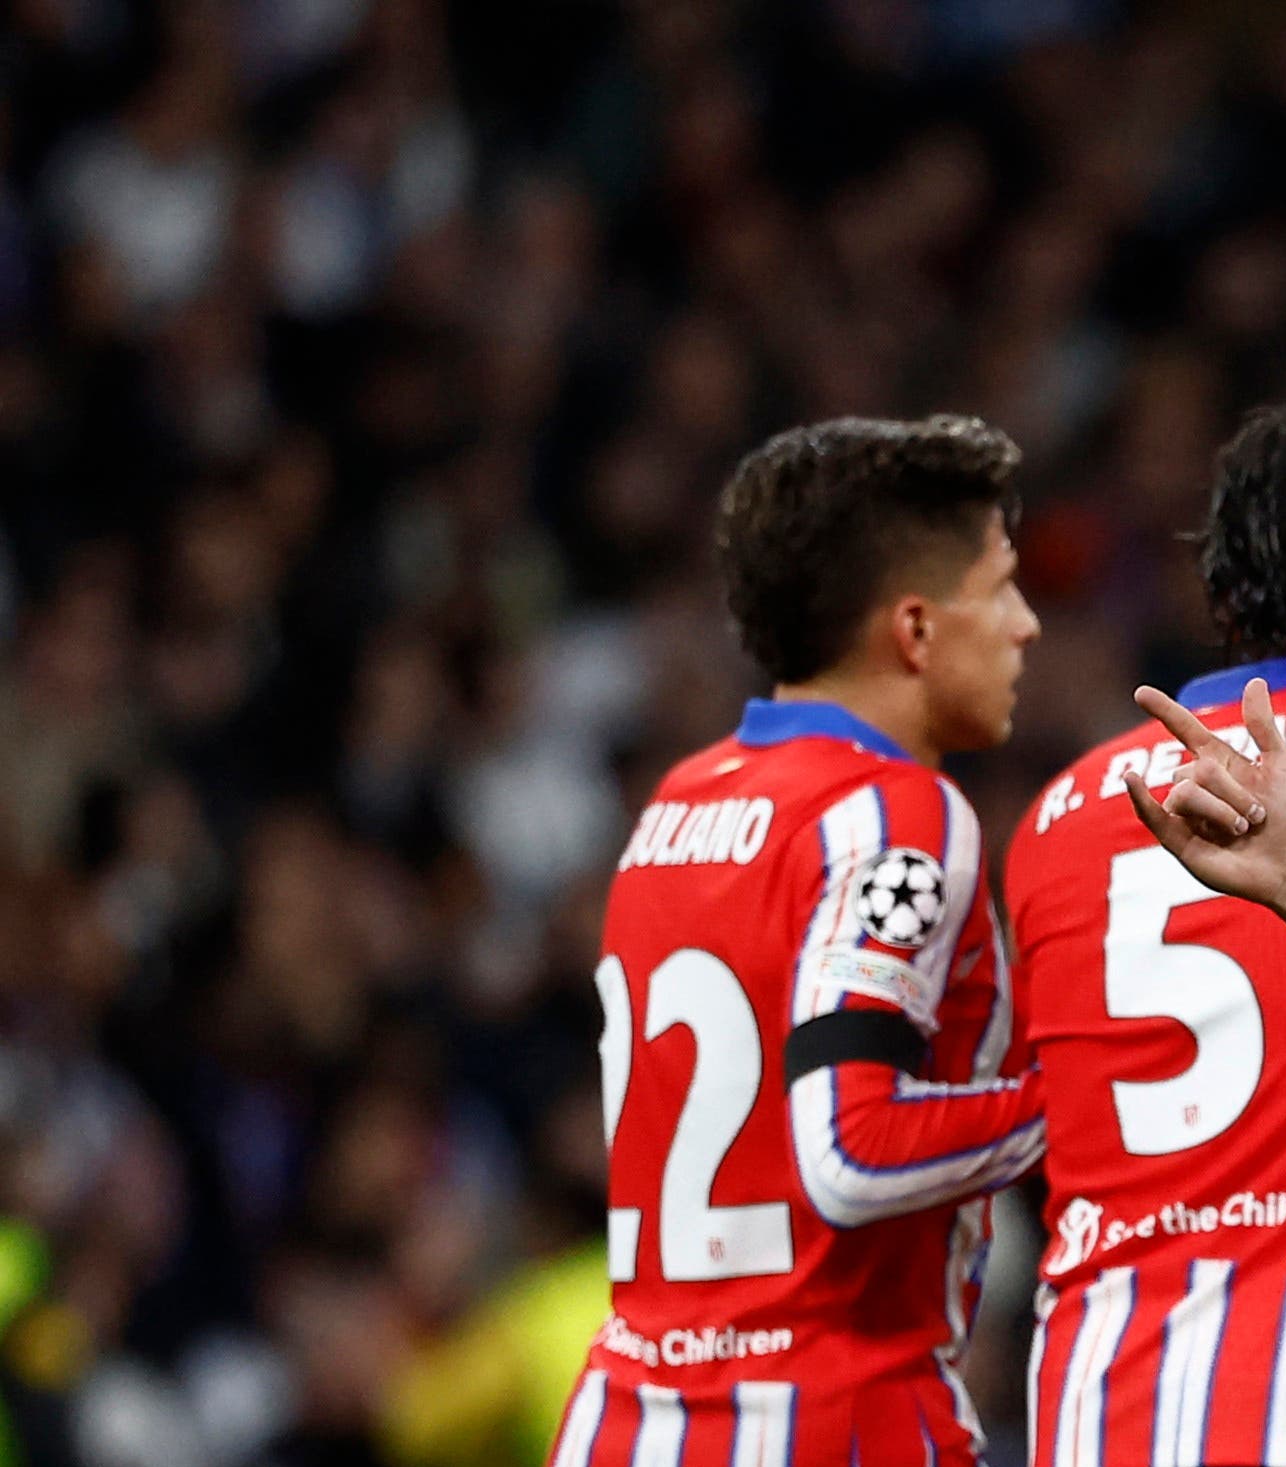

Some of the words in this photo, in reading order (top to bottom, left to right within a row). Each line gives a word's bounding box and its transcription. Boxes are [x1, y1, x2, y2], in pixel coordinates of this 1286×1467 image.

[1035, 773, 1084, 836] R.
[1099, 739, 1188, 799] DE
[1104, 844, 1266, 1156] 5
[1159, 1201, 1219, 1235] the
[660, 1324, 794, 1368] Children
